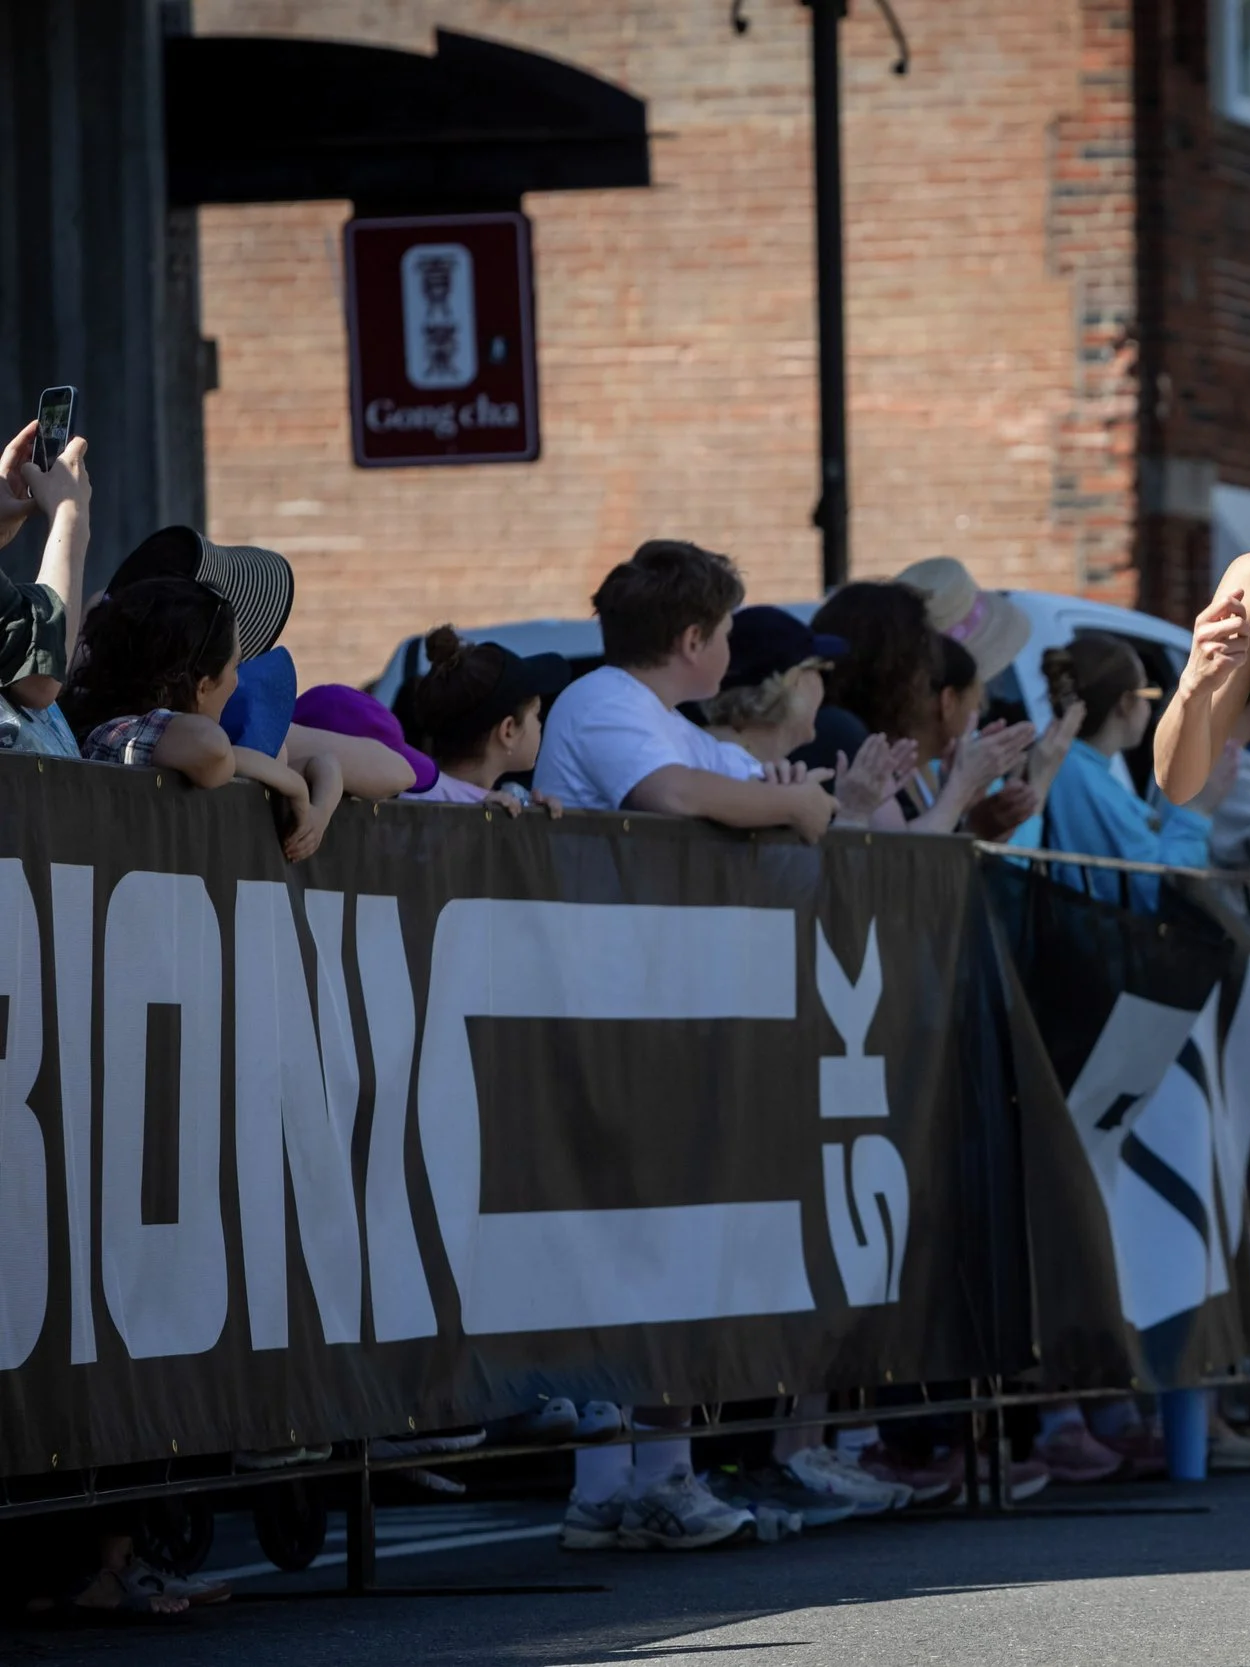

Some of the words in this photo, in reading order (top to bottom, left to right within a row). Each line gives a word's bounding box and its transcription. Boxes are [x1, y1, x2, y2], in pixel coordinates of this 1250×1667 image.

[365, 398, 458, 440] Gong
[459, 393, 519, 430] cha
[817, 916, 910, 1308] 5K
